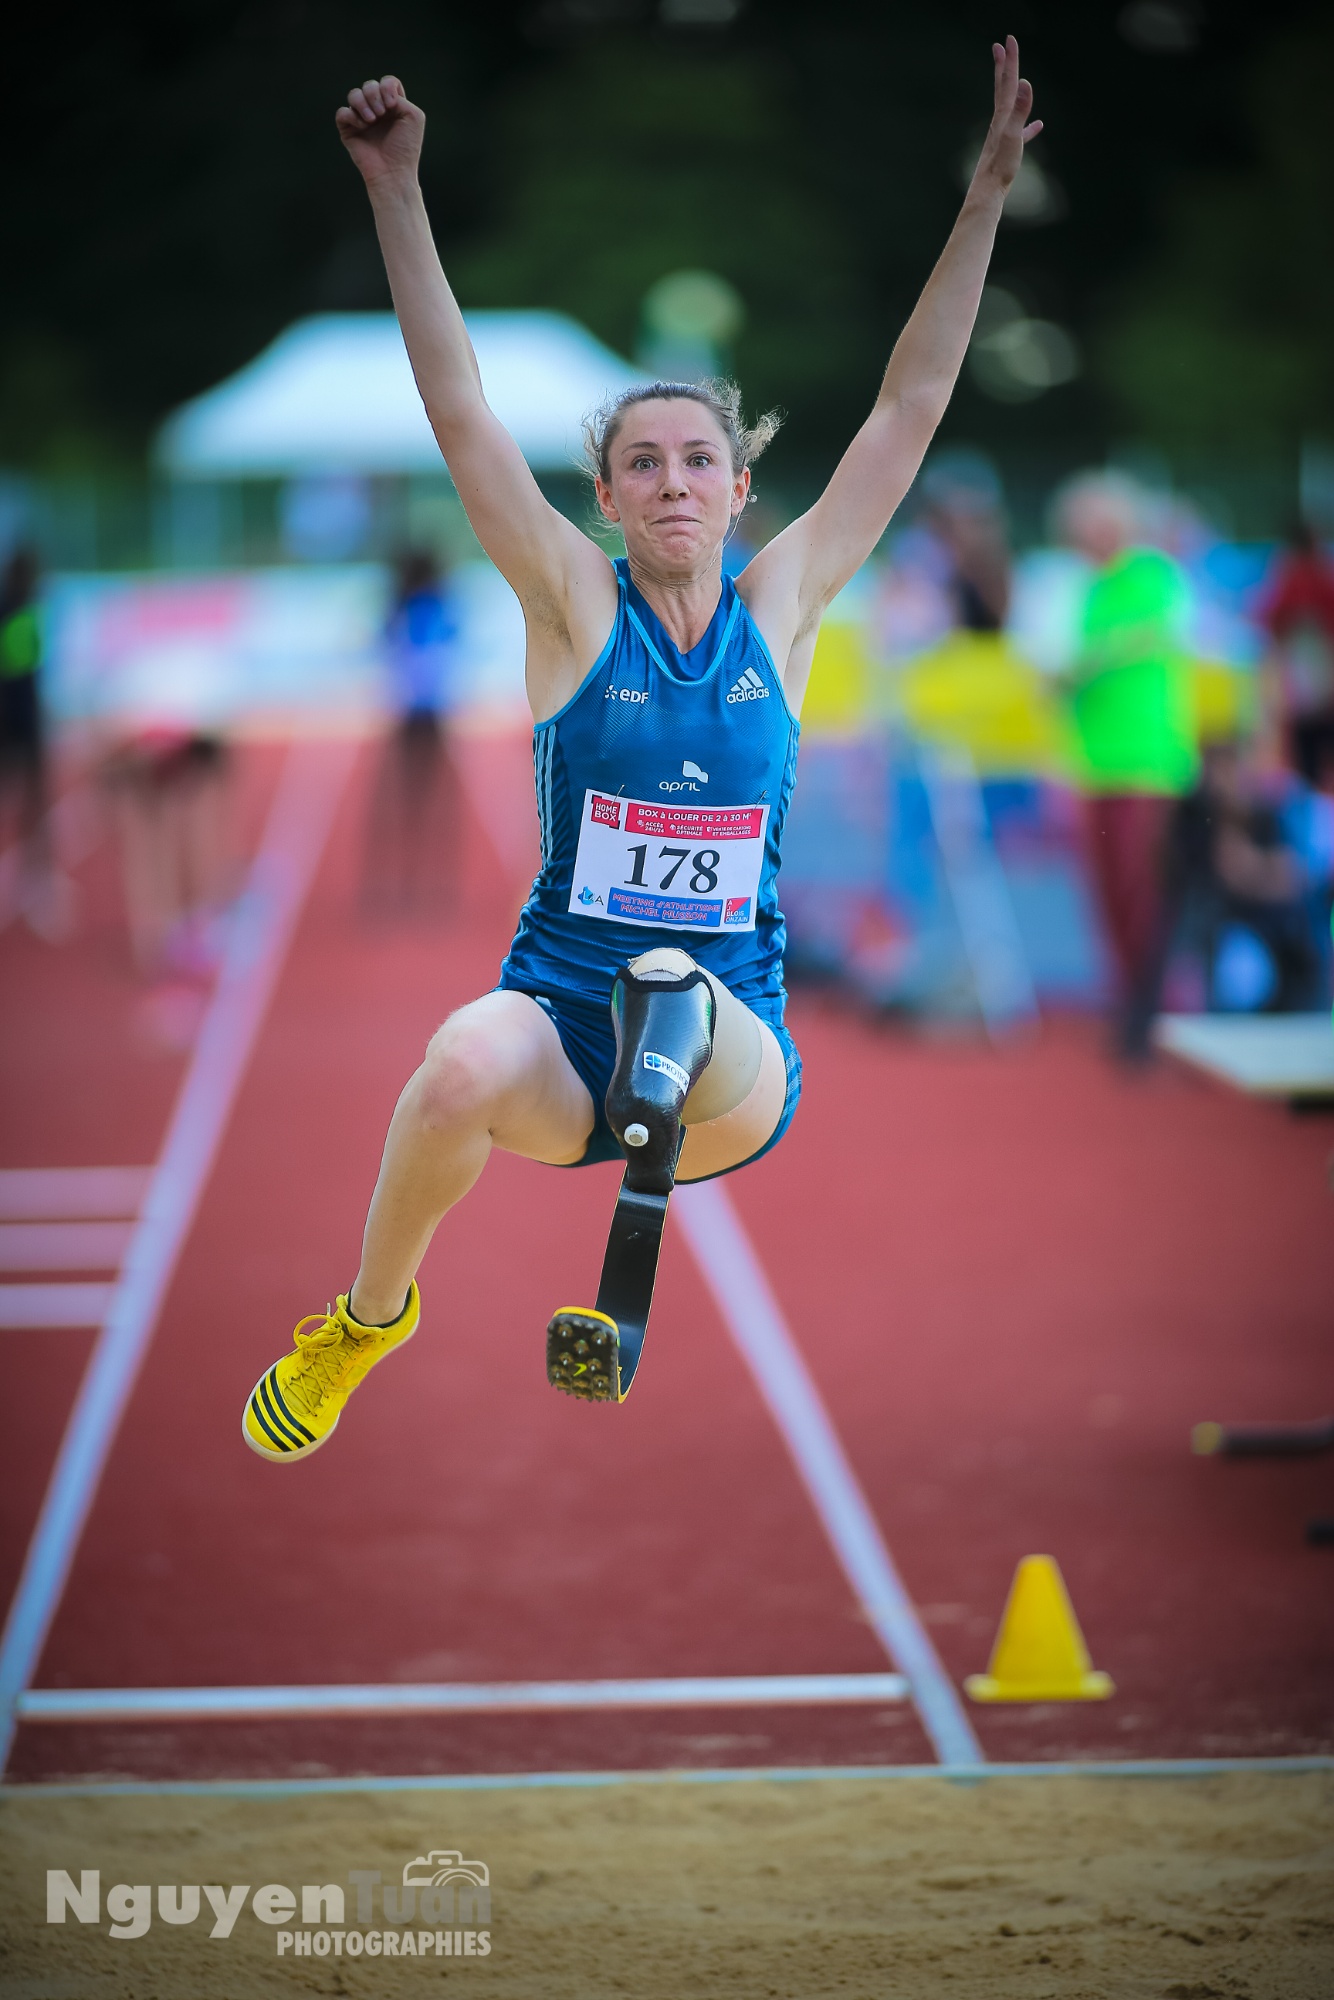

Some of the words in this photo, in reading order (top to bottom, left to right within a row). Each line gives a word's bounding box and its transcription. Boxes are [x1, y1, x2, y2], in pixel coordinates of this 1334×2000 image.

[726, 687, 770, 704] adidas
[658, 781, 701, 793] april
[595, 802, 618, 814] HOME
[638, 808, 658, 818] BOX
[668, 812, 699, 821] LOUER
[701, 814, 714, 822] DE
[730, 813, 740, 821] 30
[594, 810, 616, 822] BOX
[624, 844, 720, 894] 178
[612, 893, 655, 907] MEETING
[620, 903, 660, 917] MICHEL
[662, 910, 708, 921] MUSSON
